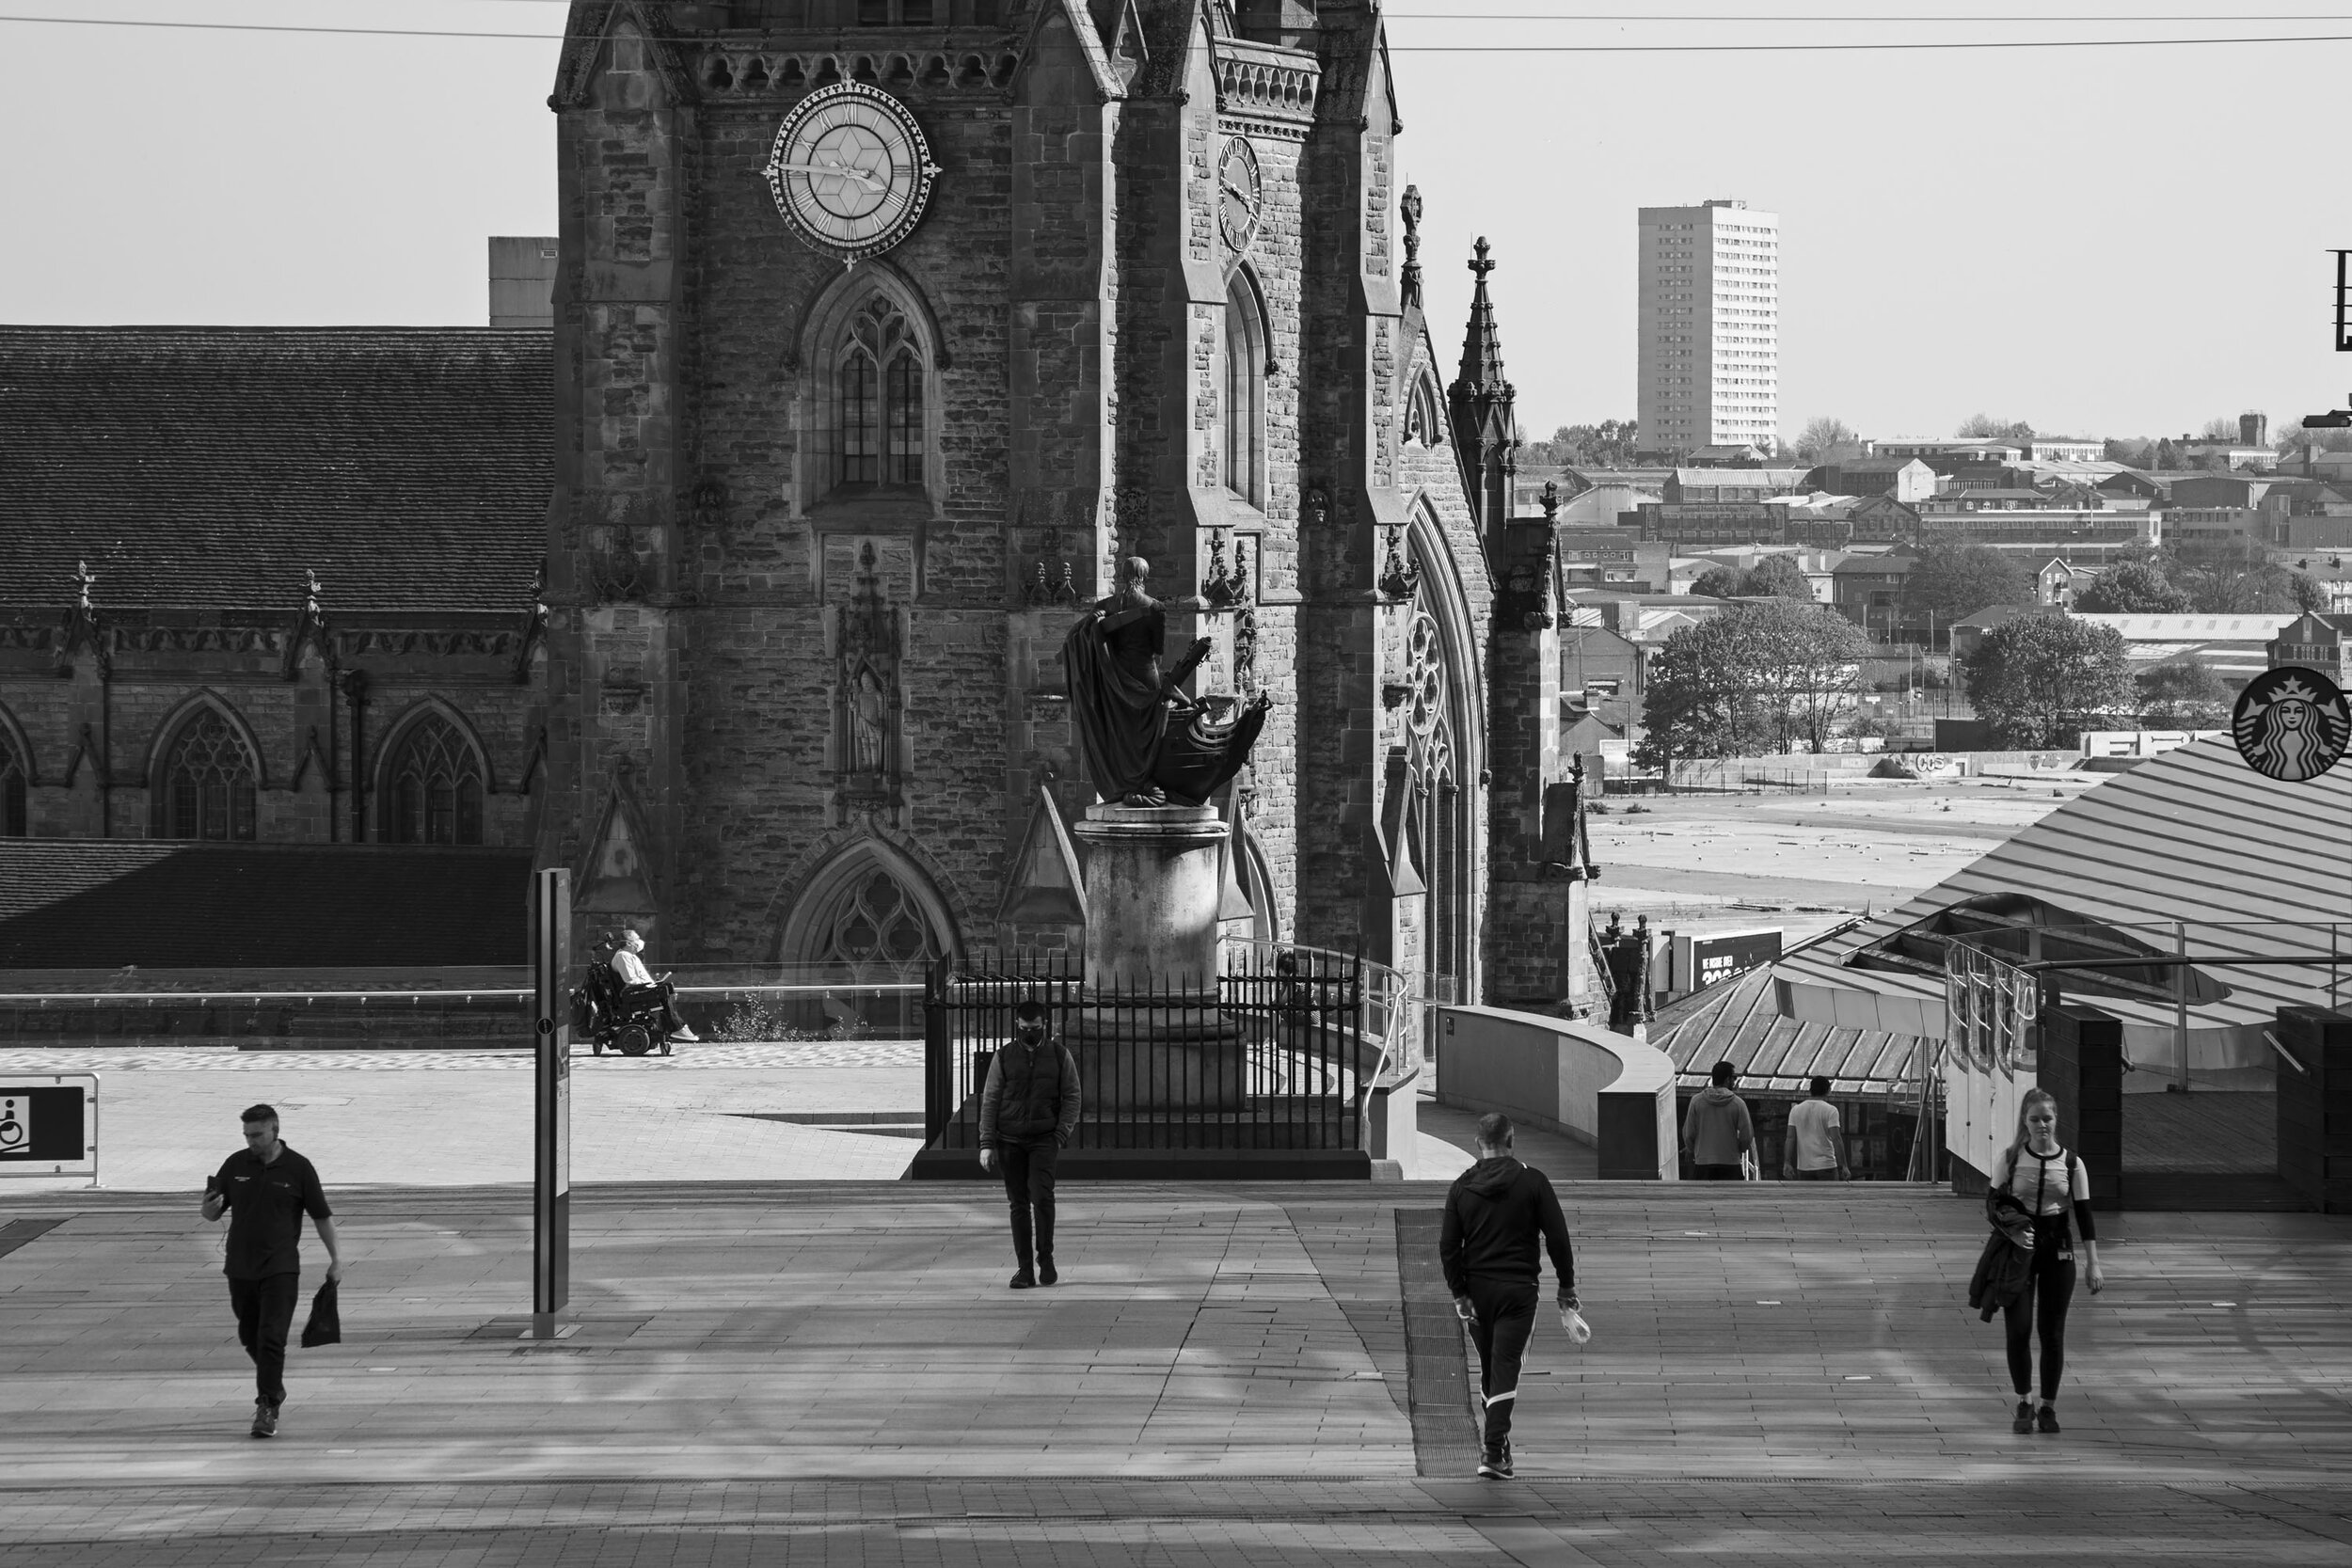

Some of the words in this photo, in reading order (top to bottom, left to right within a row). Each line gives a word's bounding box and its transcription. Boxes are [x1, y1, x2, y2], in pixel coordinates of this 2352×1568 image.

[815, 110, 834, 133] XI
[842, 103, 858, 125] XII
[871, 112, 882, 131] I
[886, 134, 905, 150] II
[844, 219, 857, 240] VI
